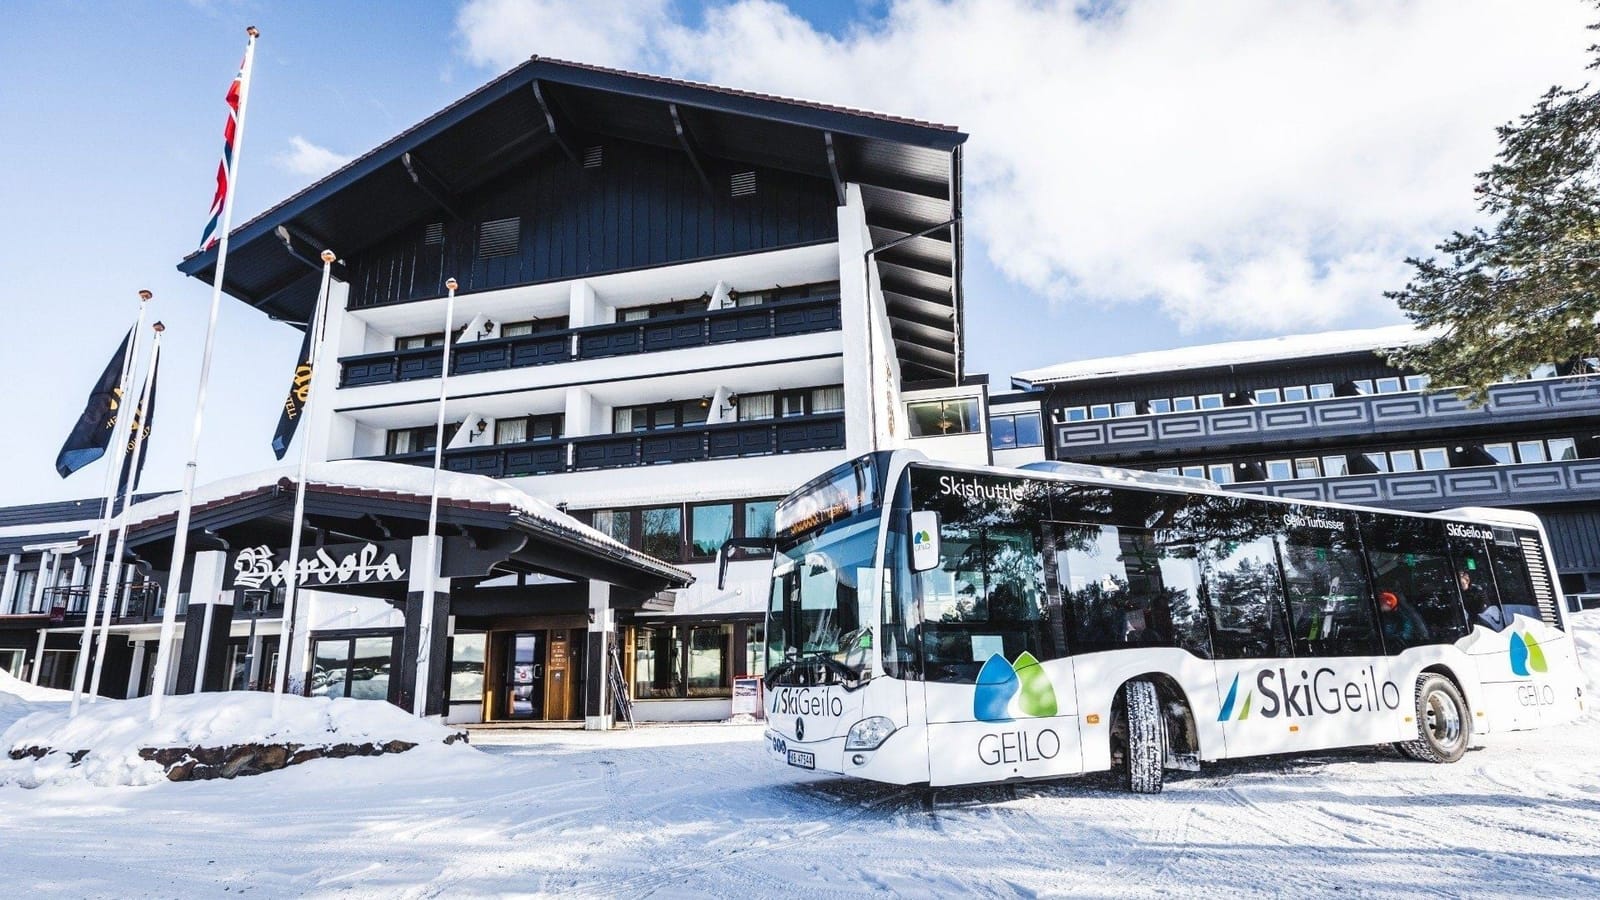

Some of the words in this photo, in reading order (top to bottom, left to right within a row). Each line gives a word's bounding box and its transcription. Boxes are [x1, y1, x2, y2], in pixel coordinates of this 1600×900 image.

[284, 396, 297, 420] TELL
[939, 475, 1024, 501] Skishuttle
[1283, 513, 1306, 527] Geilo
[1305, 515, 1345, 530] Turbusser
[1446, 522, 1494, 540] SkiGeilo.no
[233, 542, 406, 590] Bardøla
[780, 686, 843, 717] SkiGeilo
[1256, 664, 1400, 718] SkiGeilo
[1517, 684, 1555, 707] GEILO
[978, 728, 1061, 766] GEILO
